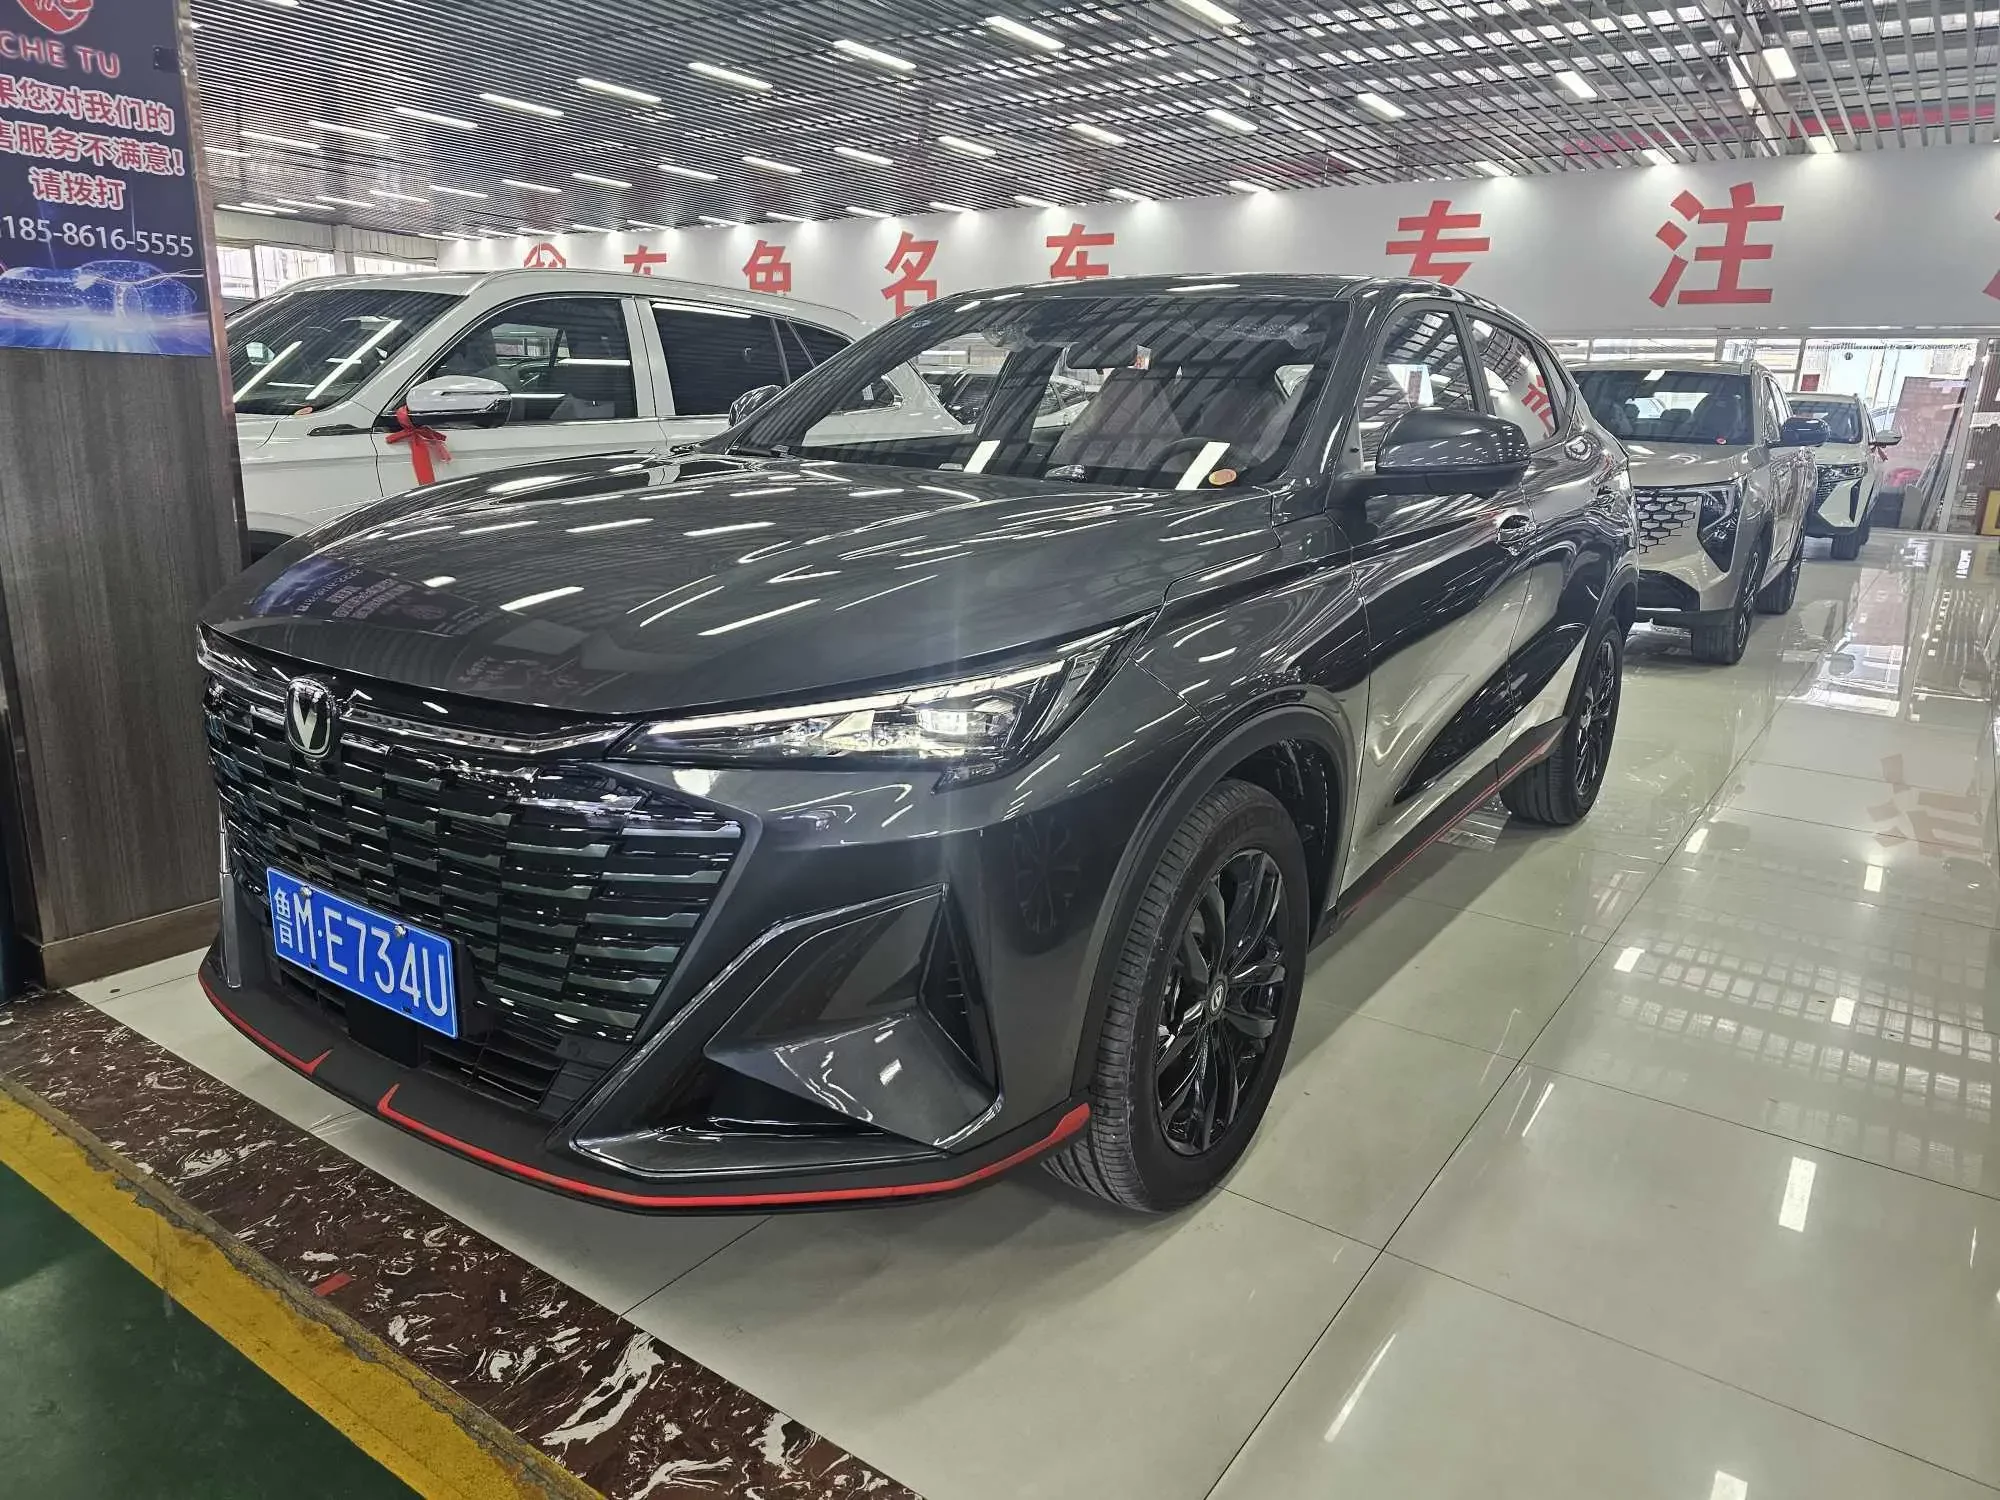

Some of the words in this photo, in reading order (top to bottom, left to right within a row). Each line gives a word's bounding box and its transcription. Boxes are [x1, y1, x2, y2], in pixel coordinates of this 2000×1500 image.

[0, 30, 67, 68] CHE
[73, 44, 120, 78] TU
[28, 167, 126, 210] 请拨打
